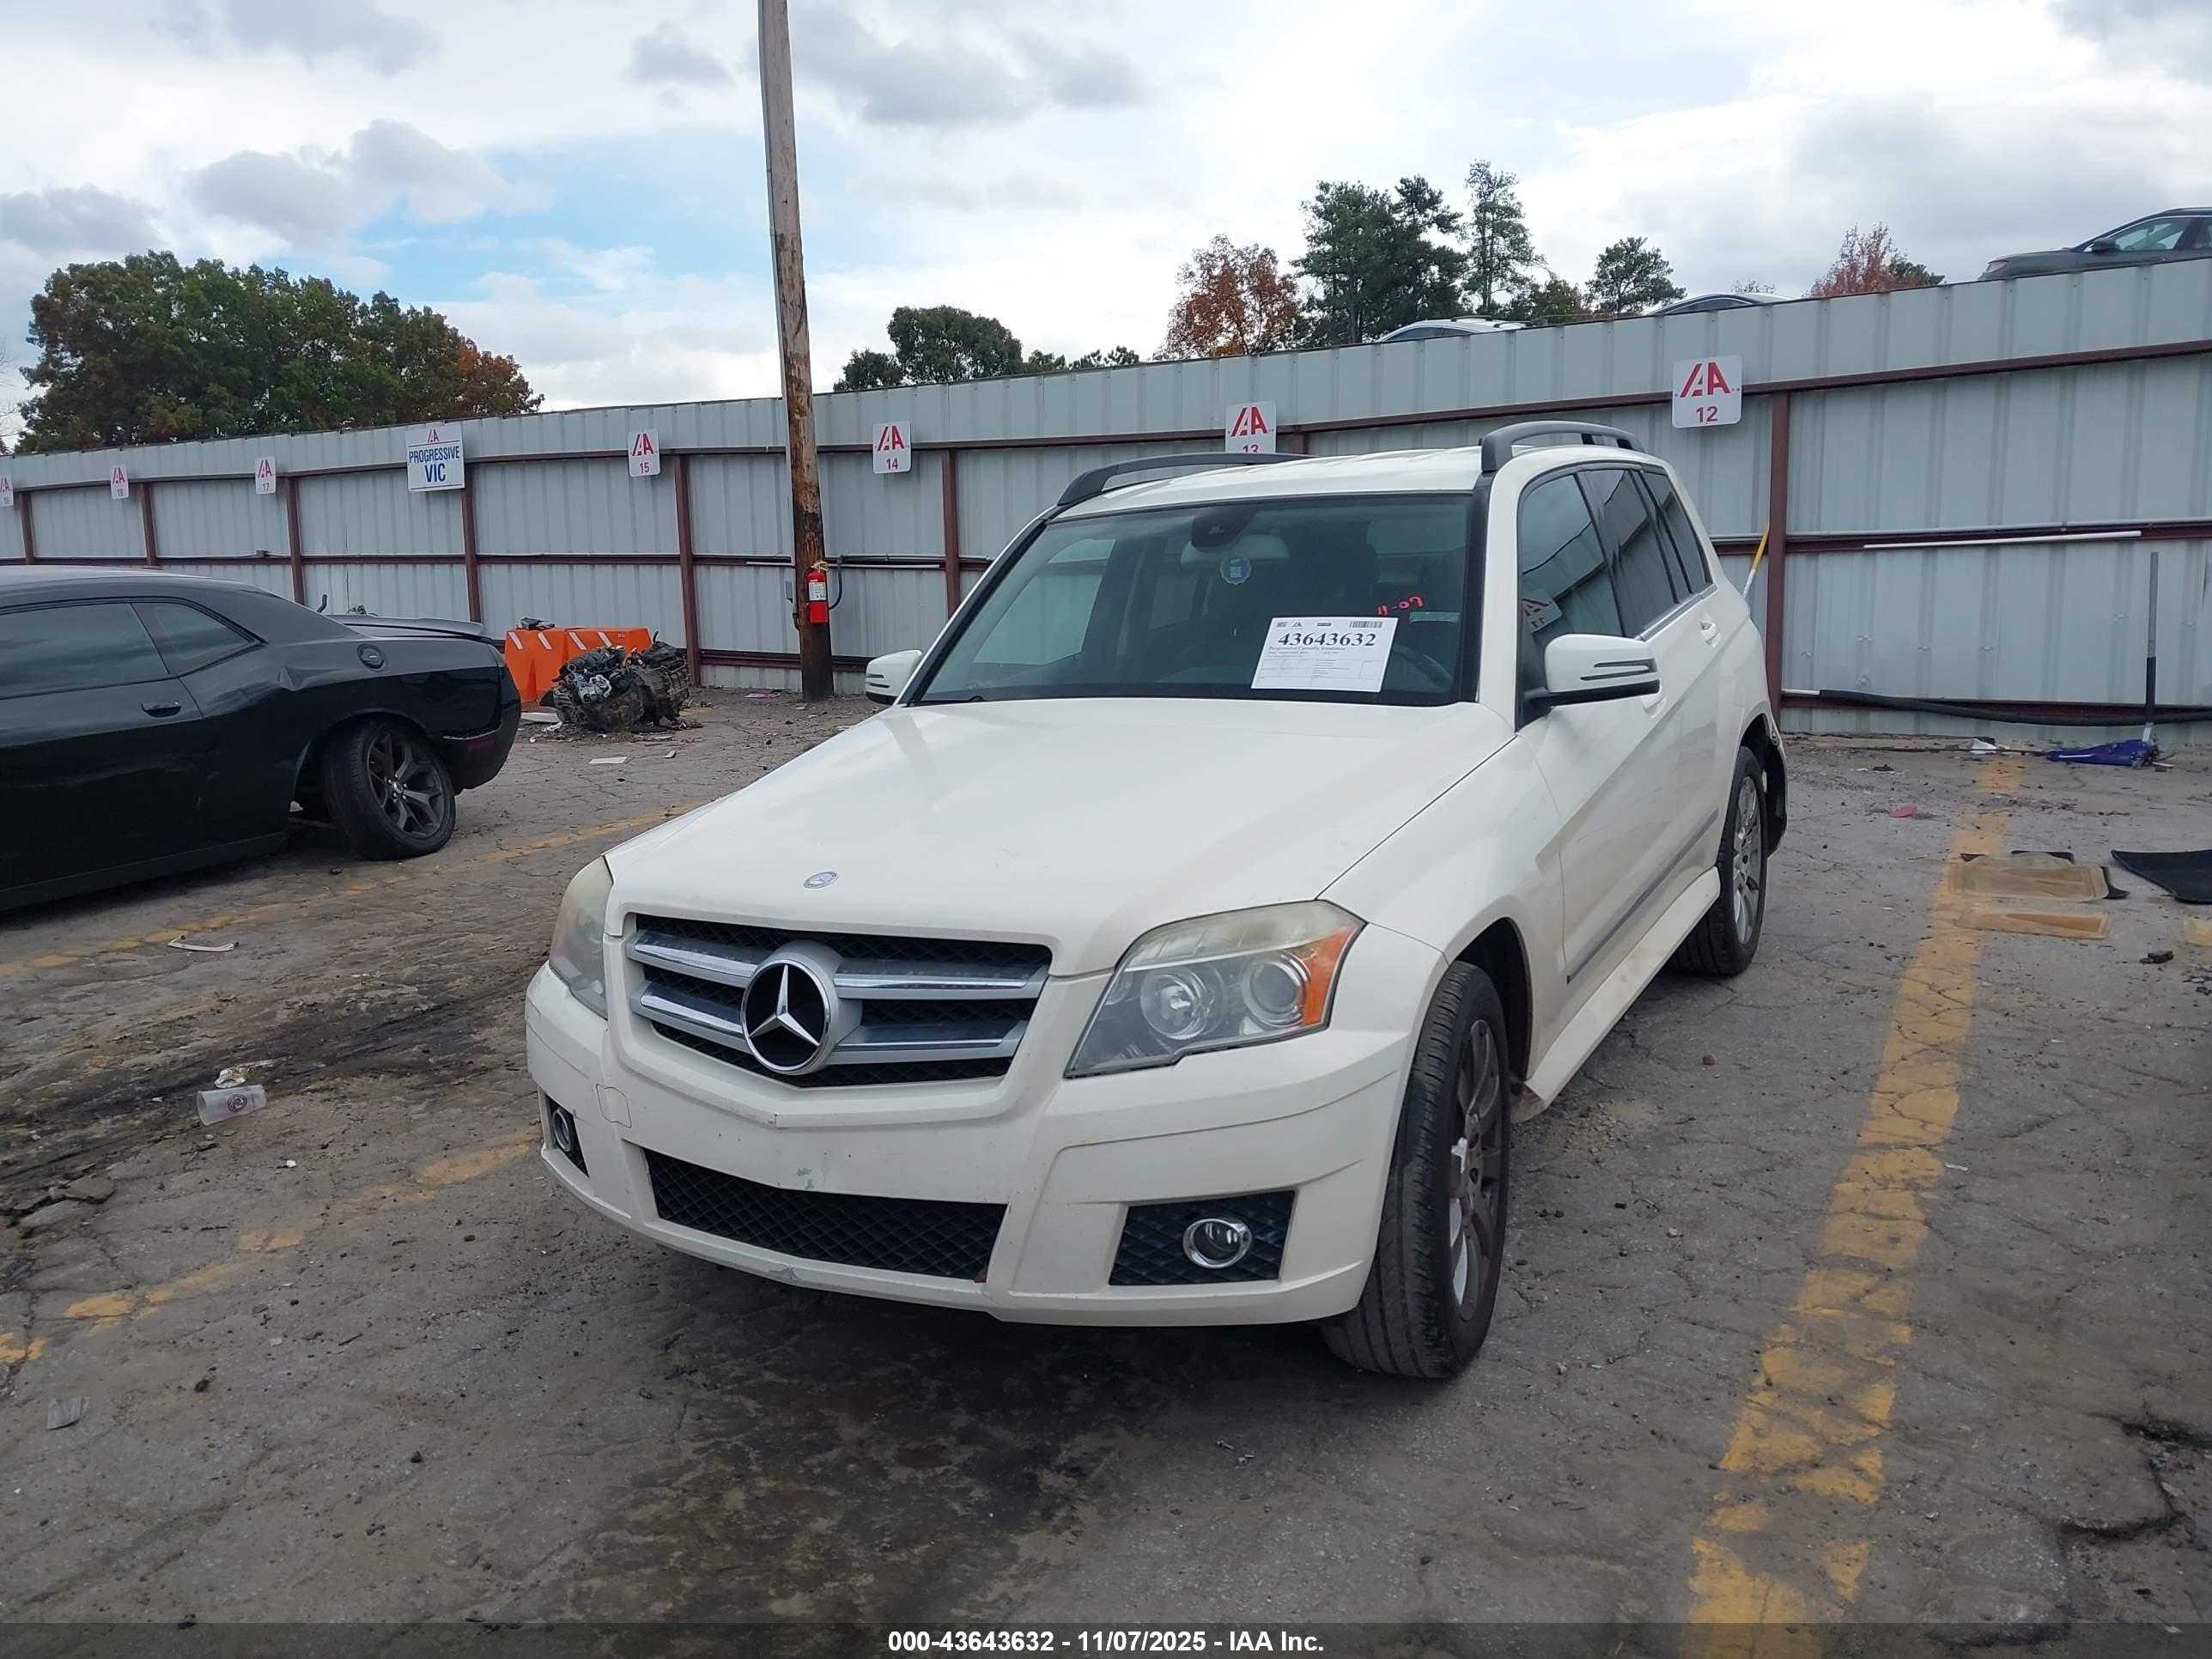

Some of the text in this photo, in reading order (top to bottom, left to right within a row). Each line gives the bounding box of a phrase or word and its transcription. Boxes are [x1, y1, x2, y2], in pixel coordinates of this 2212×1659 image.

[1696, 406, 1718, 422] 12
[409, 447, 460, 464] PROGRESSIVE
[639, 462, 650, 473] 15
[886, 459, 899, 471] 14
[424, 464, 447, 483] VIC
[263, 483, 270, 491] 17
[1278, 632, 1377, 647] 43643632
